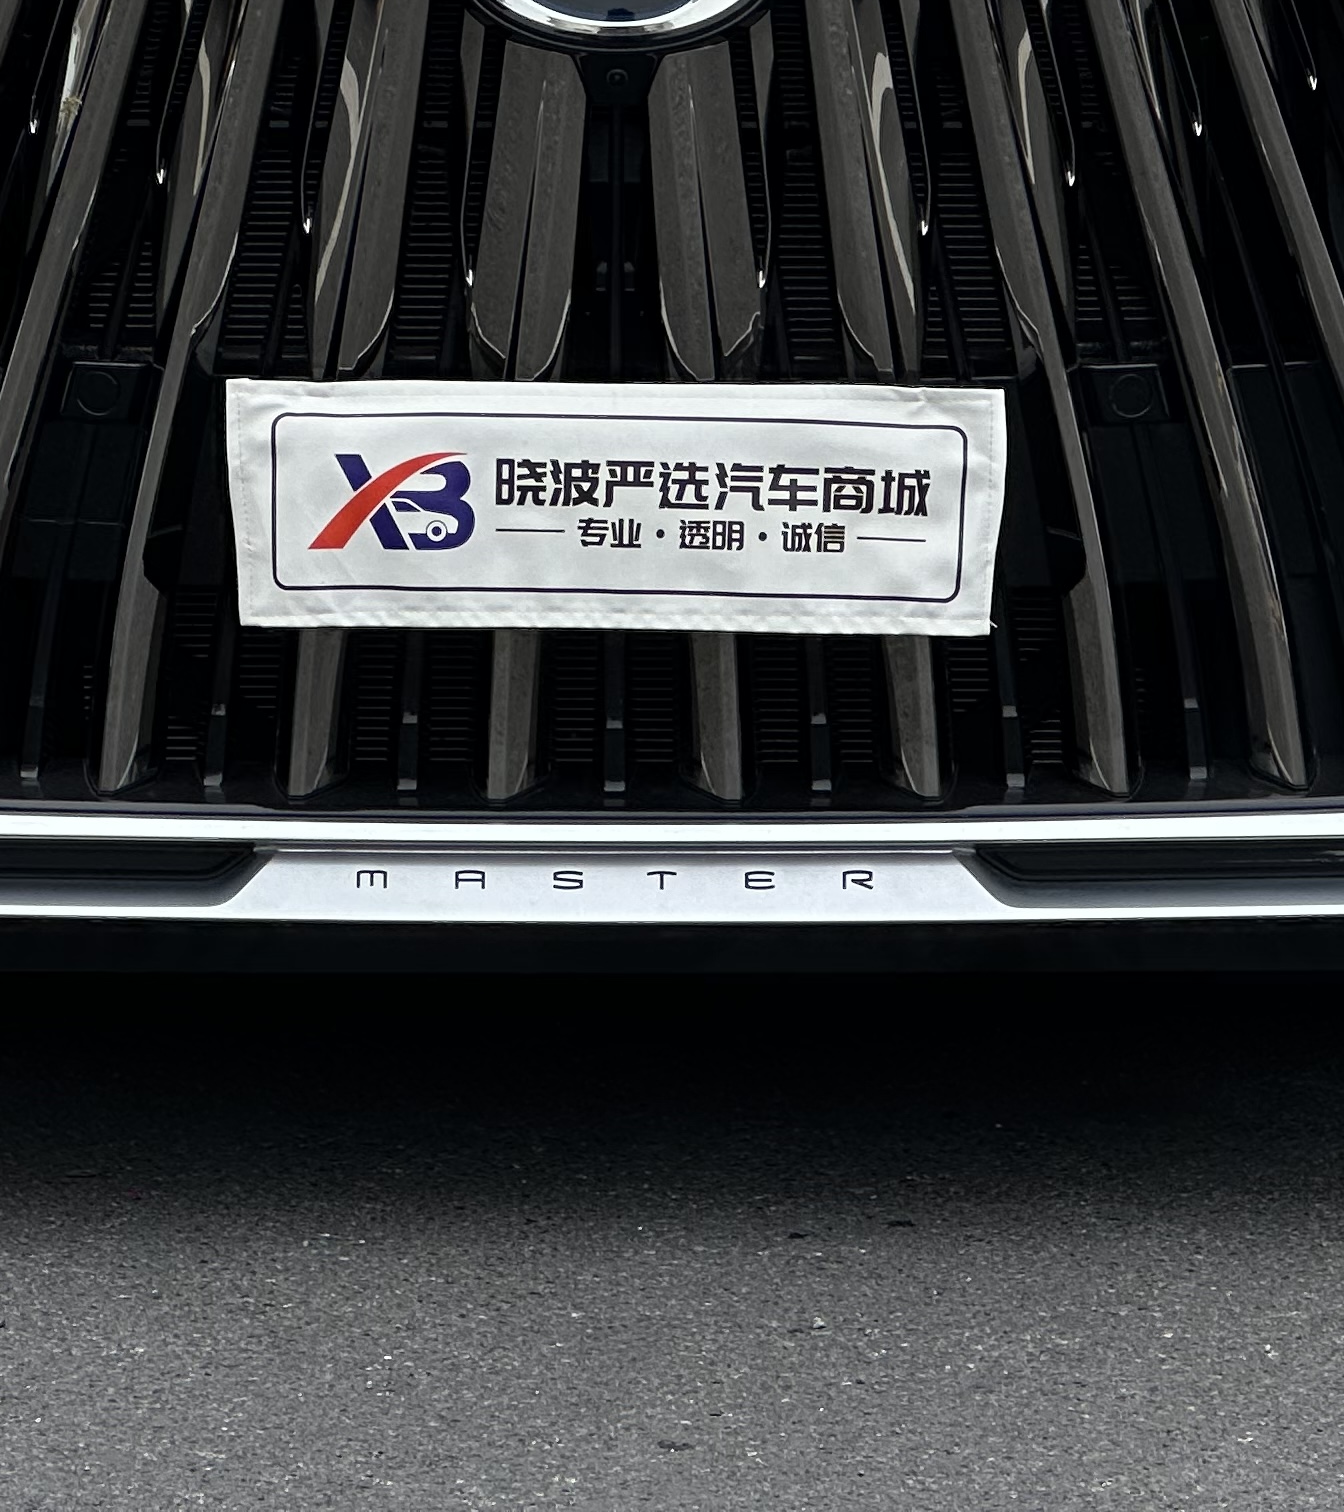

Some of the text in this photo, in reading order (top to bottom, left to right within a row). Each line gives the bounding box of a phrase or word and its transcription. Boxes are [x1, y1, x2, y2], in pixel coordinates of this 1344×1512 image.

[495, 458, 931, 518] 晓波严选汽车商城
[355, 869, 874, 891] MASTER
